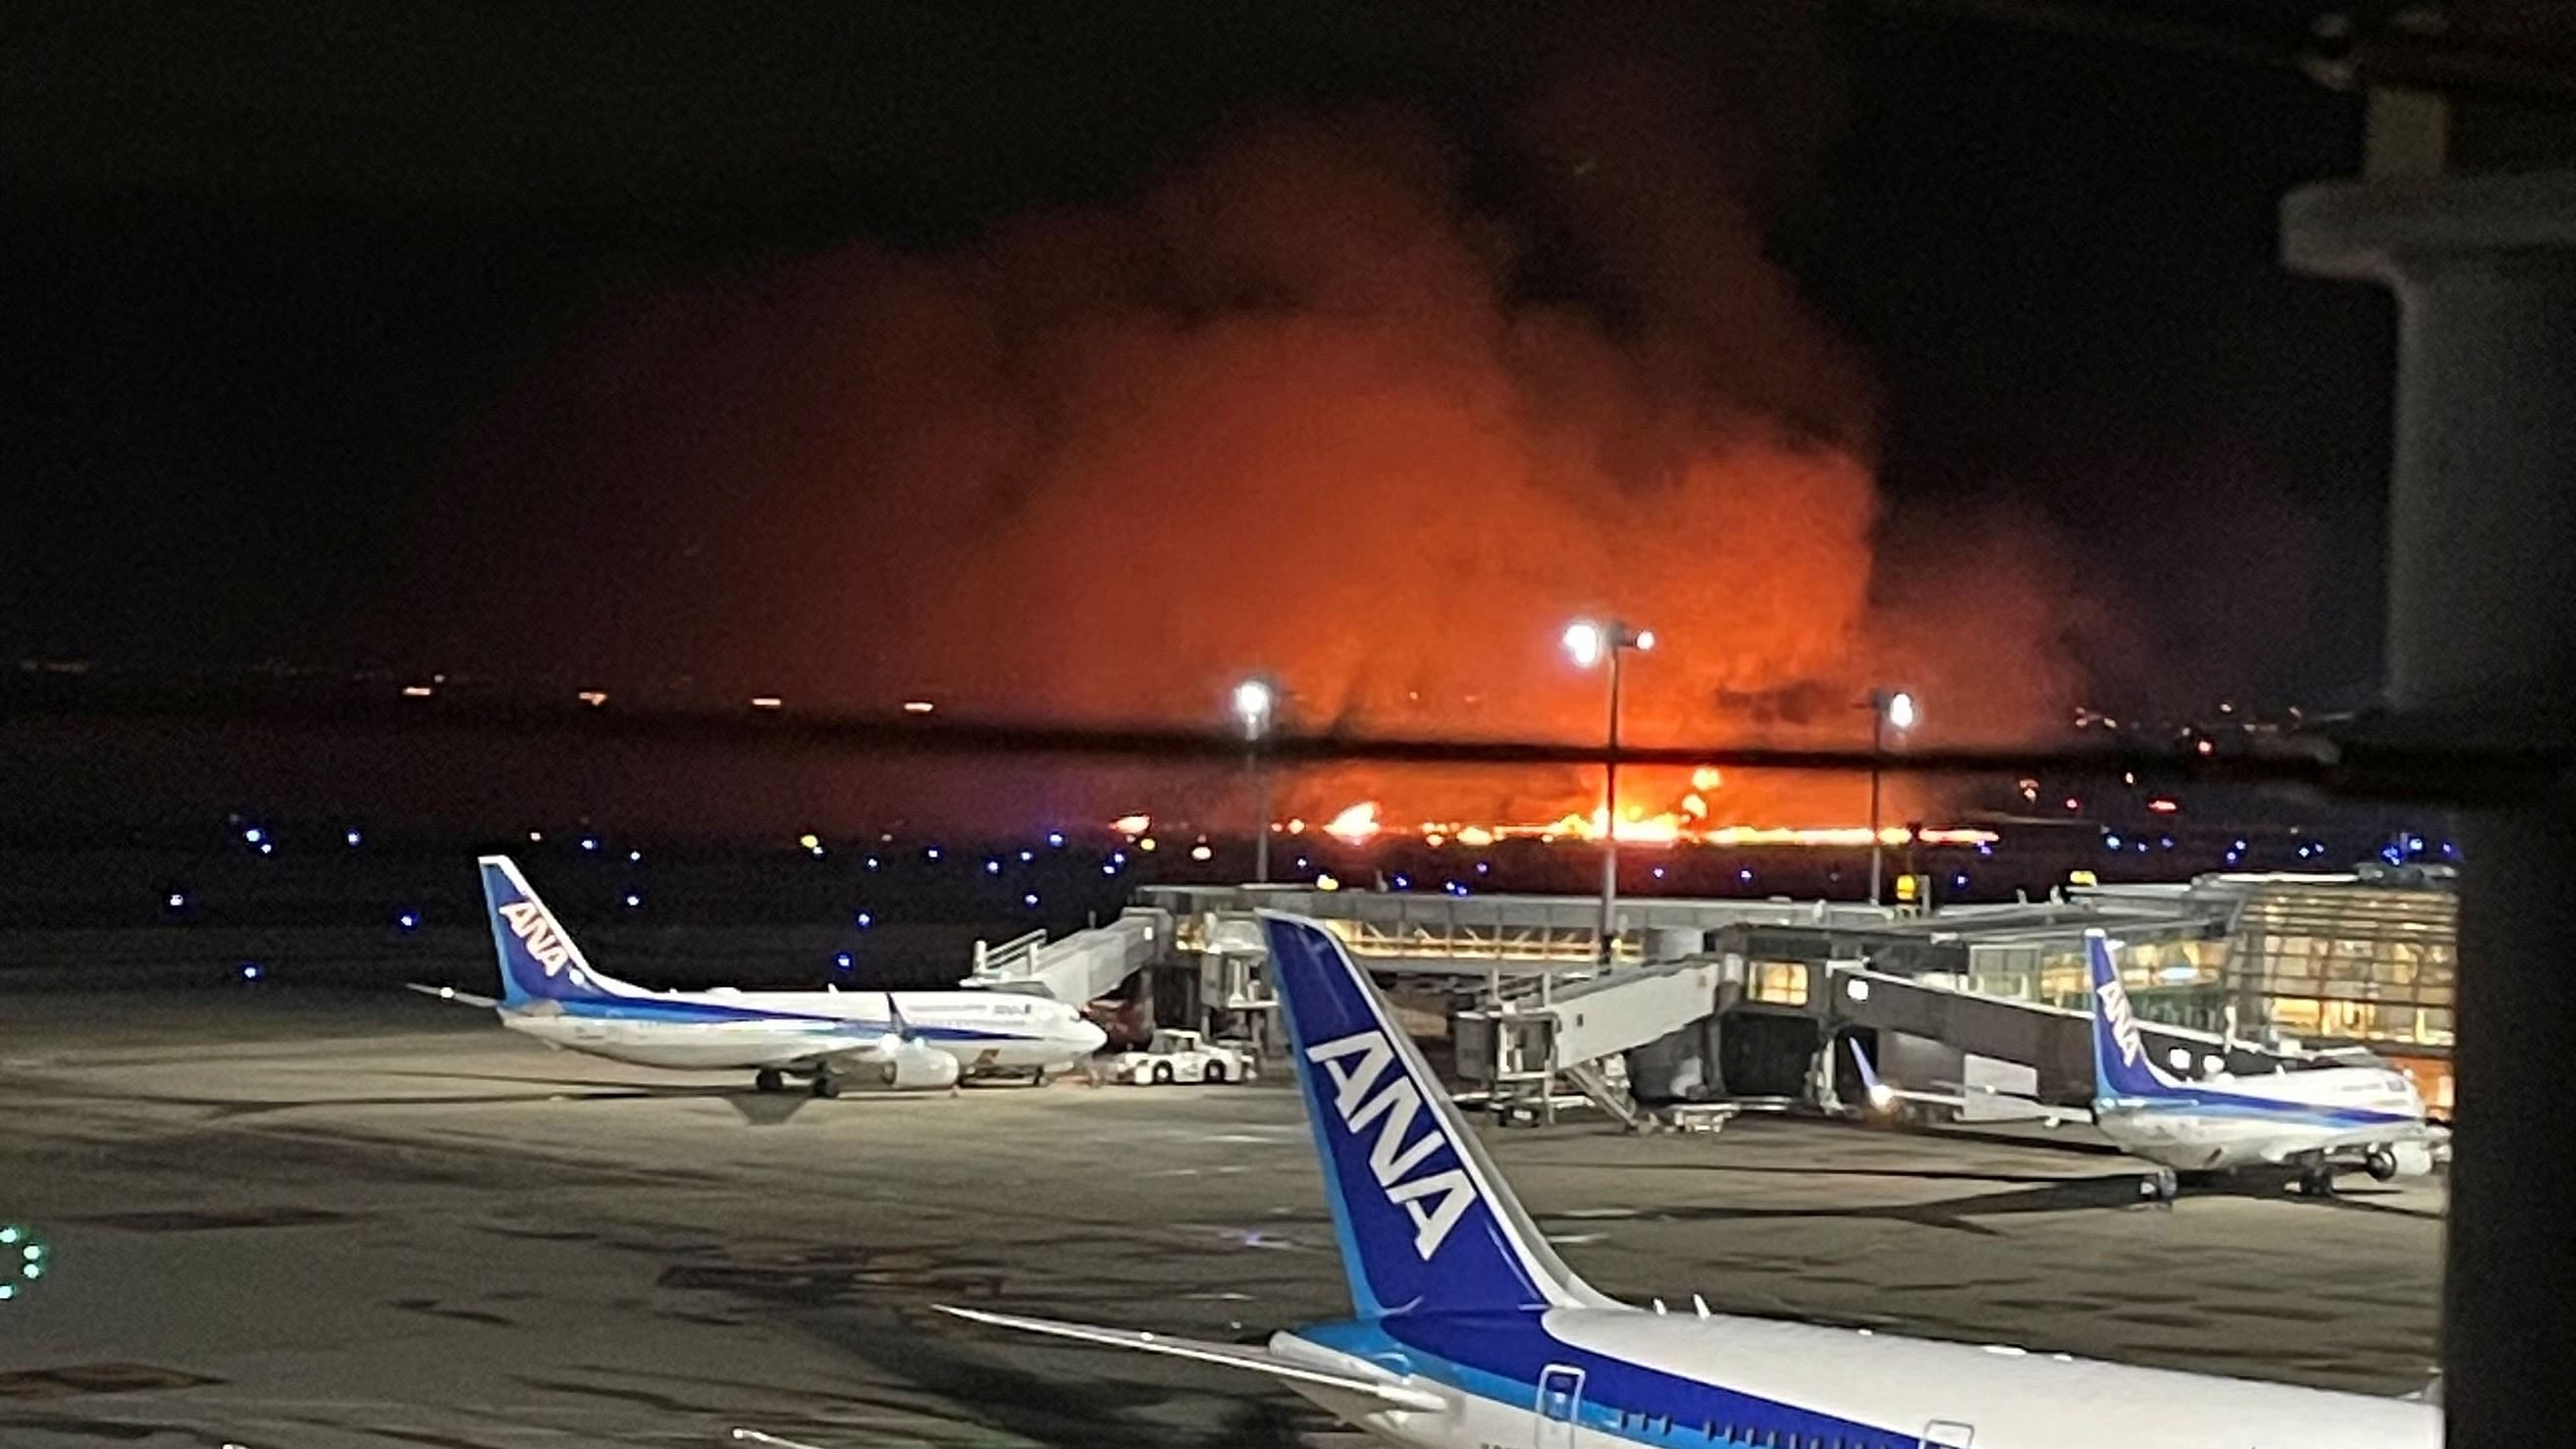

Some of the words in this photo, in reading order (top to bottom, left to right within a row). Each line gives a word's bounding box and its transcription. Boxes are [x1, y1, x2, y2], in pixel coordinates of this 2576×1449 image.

[499, 902, 568, 977] ANA
[2096, 981, 2140, 1068] ANA
[1304, 1030, 1477, 1262] ANA
